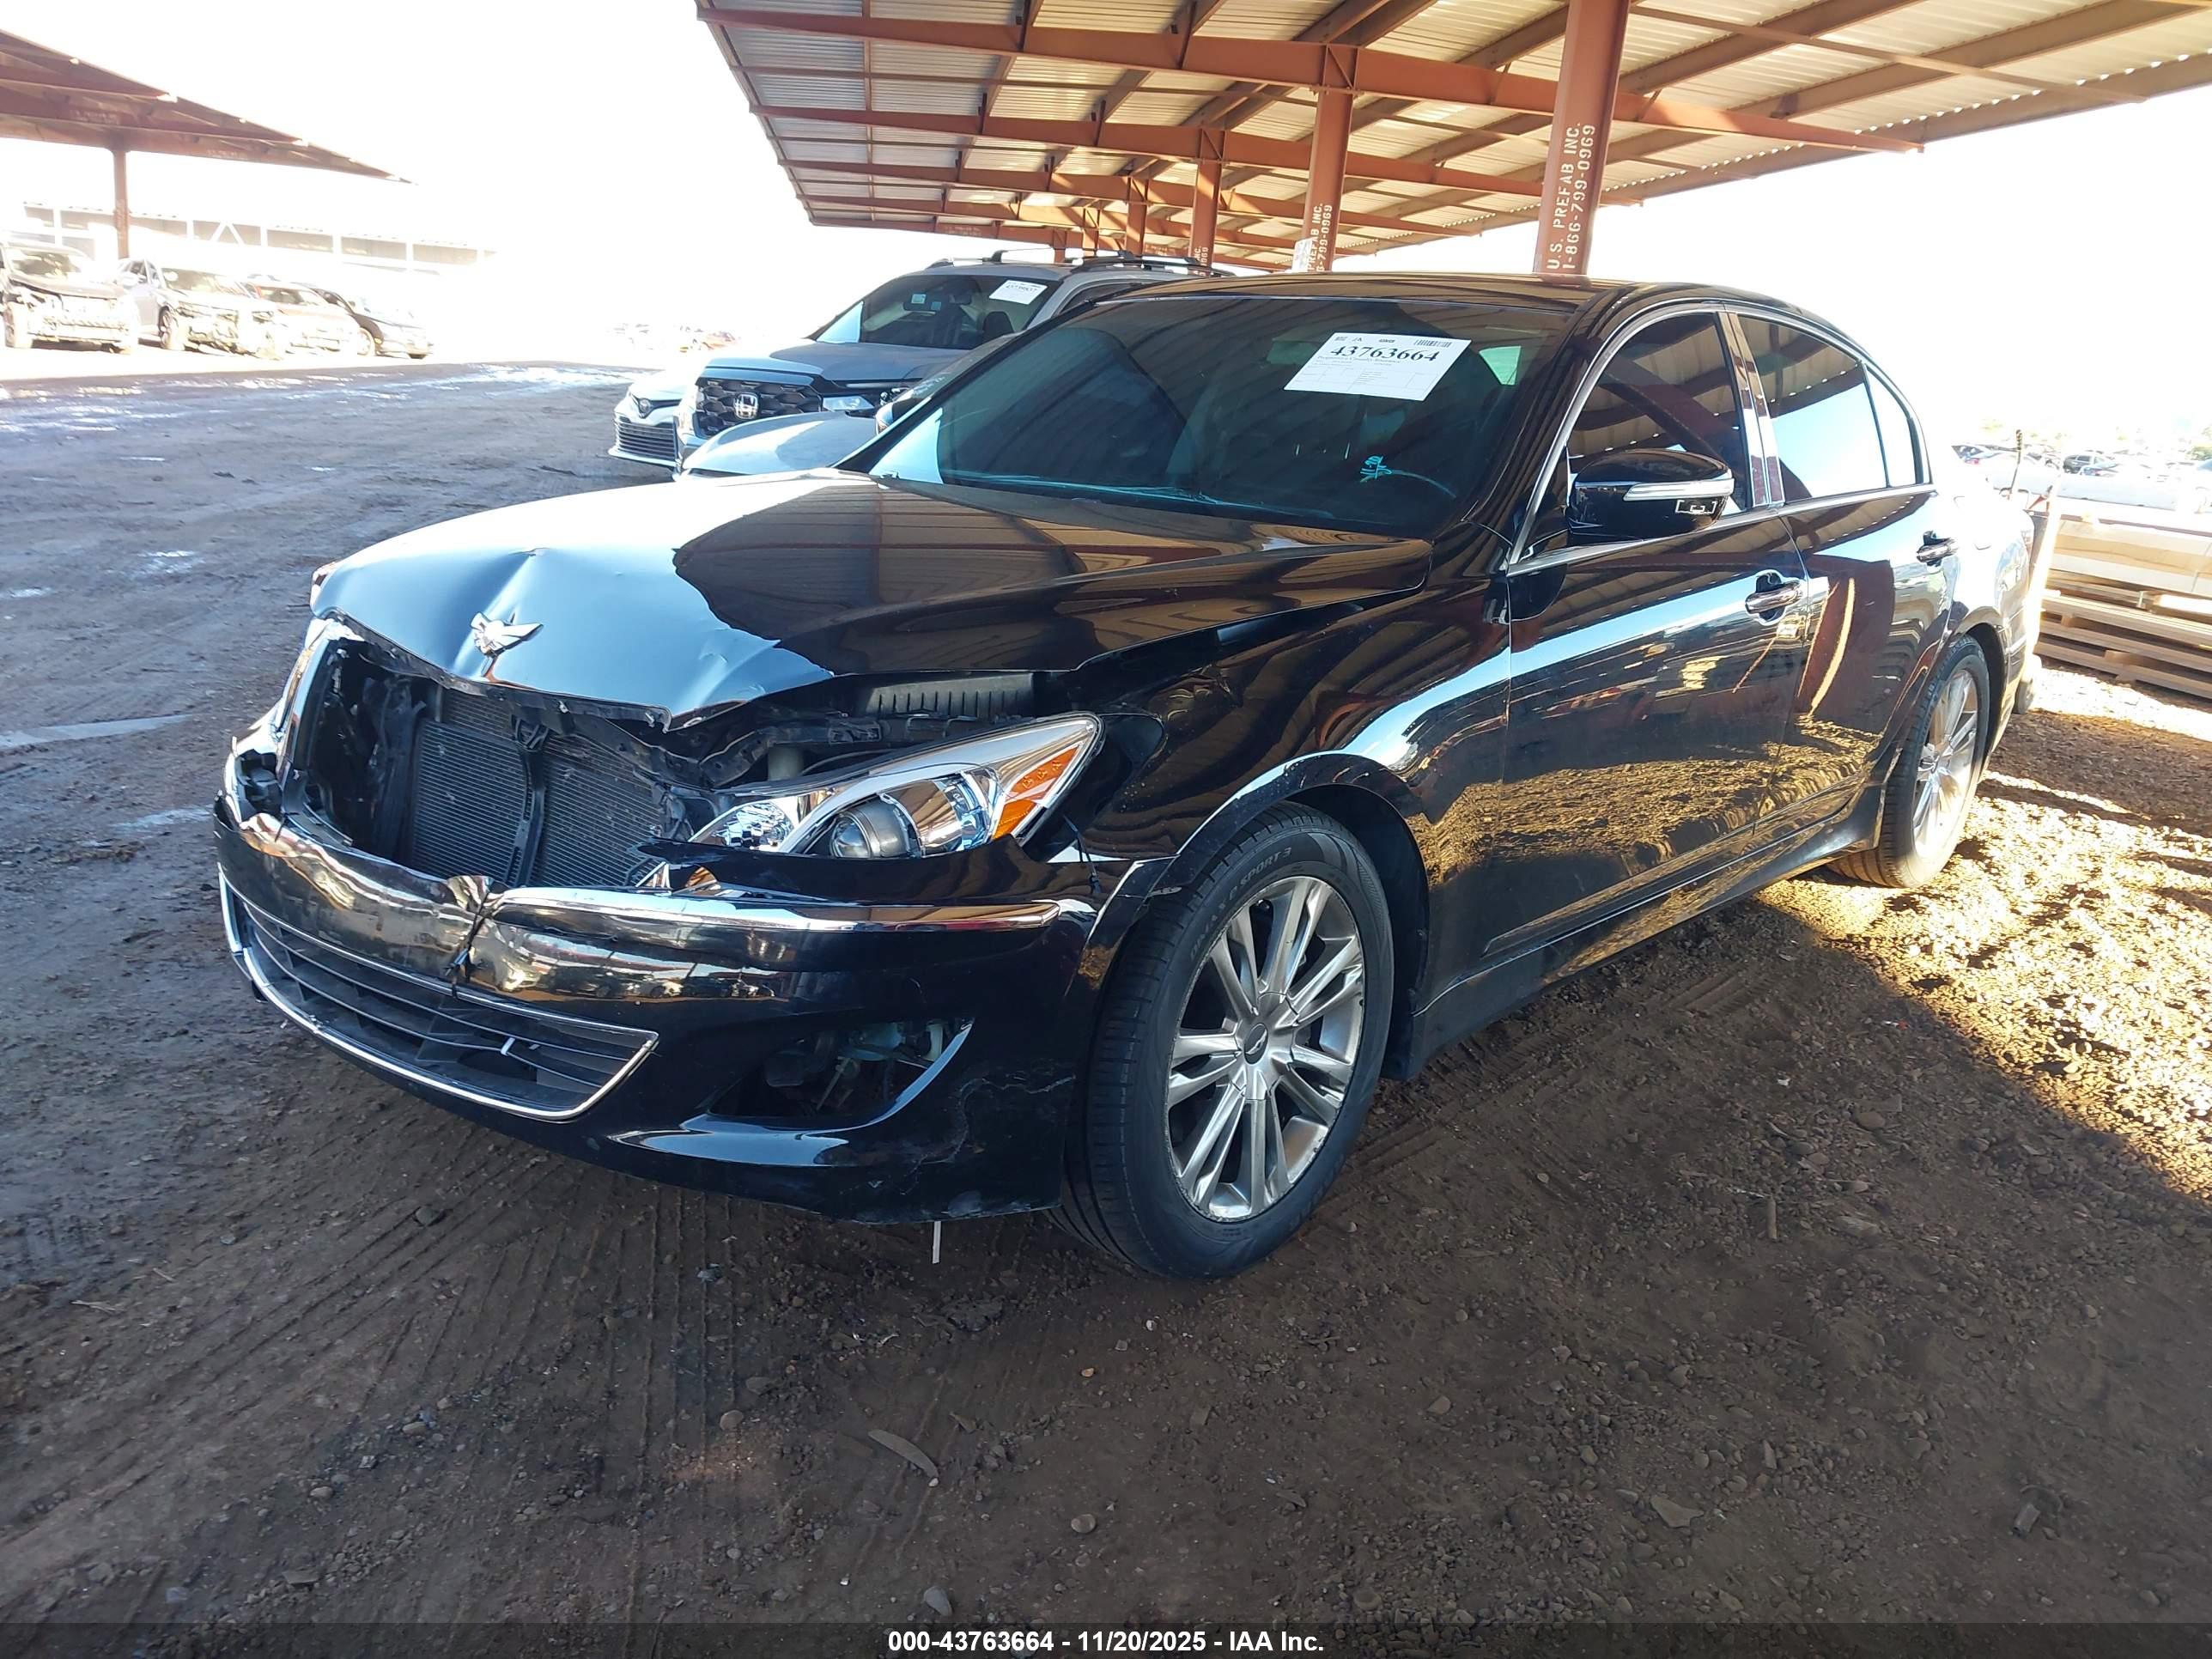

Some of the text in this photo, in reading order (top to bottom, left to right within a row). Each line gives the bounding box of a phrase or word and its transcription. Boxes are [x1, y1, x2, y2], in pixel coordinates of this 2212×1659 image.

[1547, 123, 1581, 269] U.S. PREFAB INC.
[1562, 125, 1595, 269] 1-866-799-0969
[1330, 345, 1440, 362] 43763664
